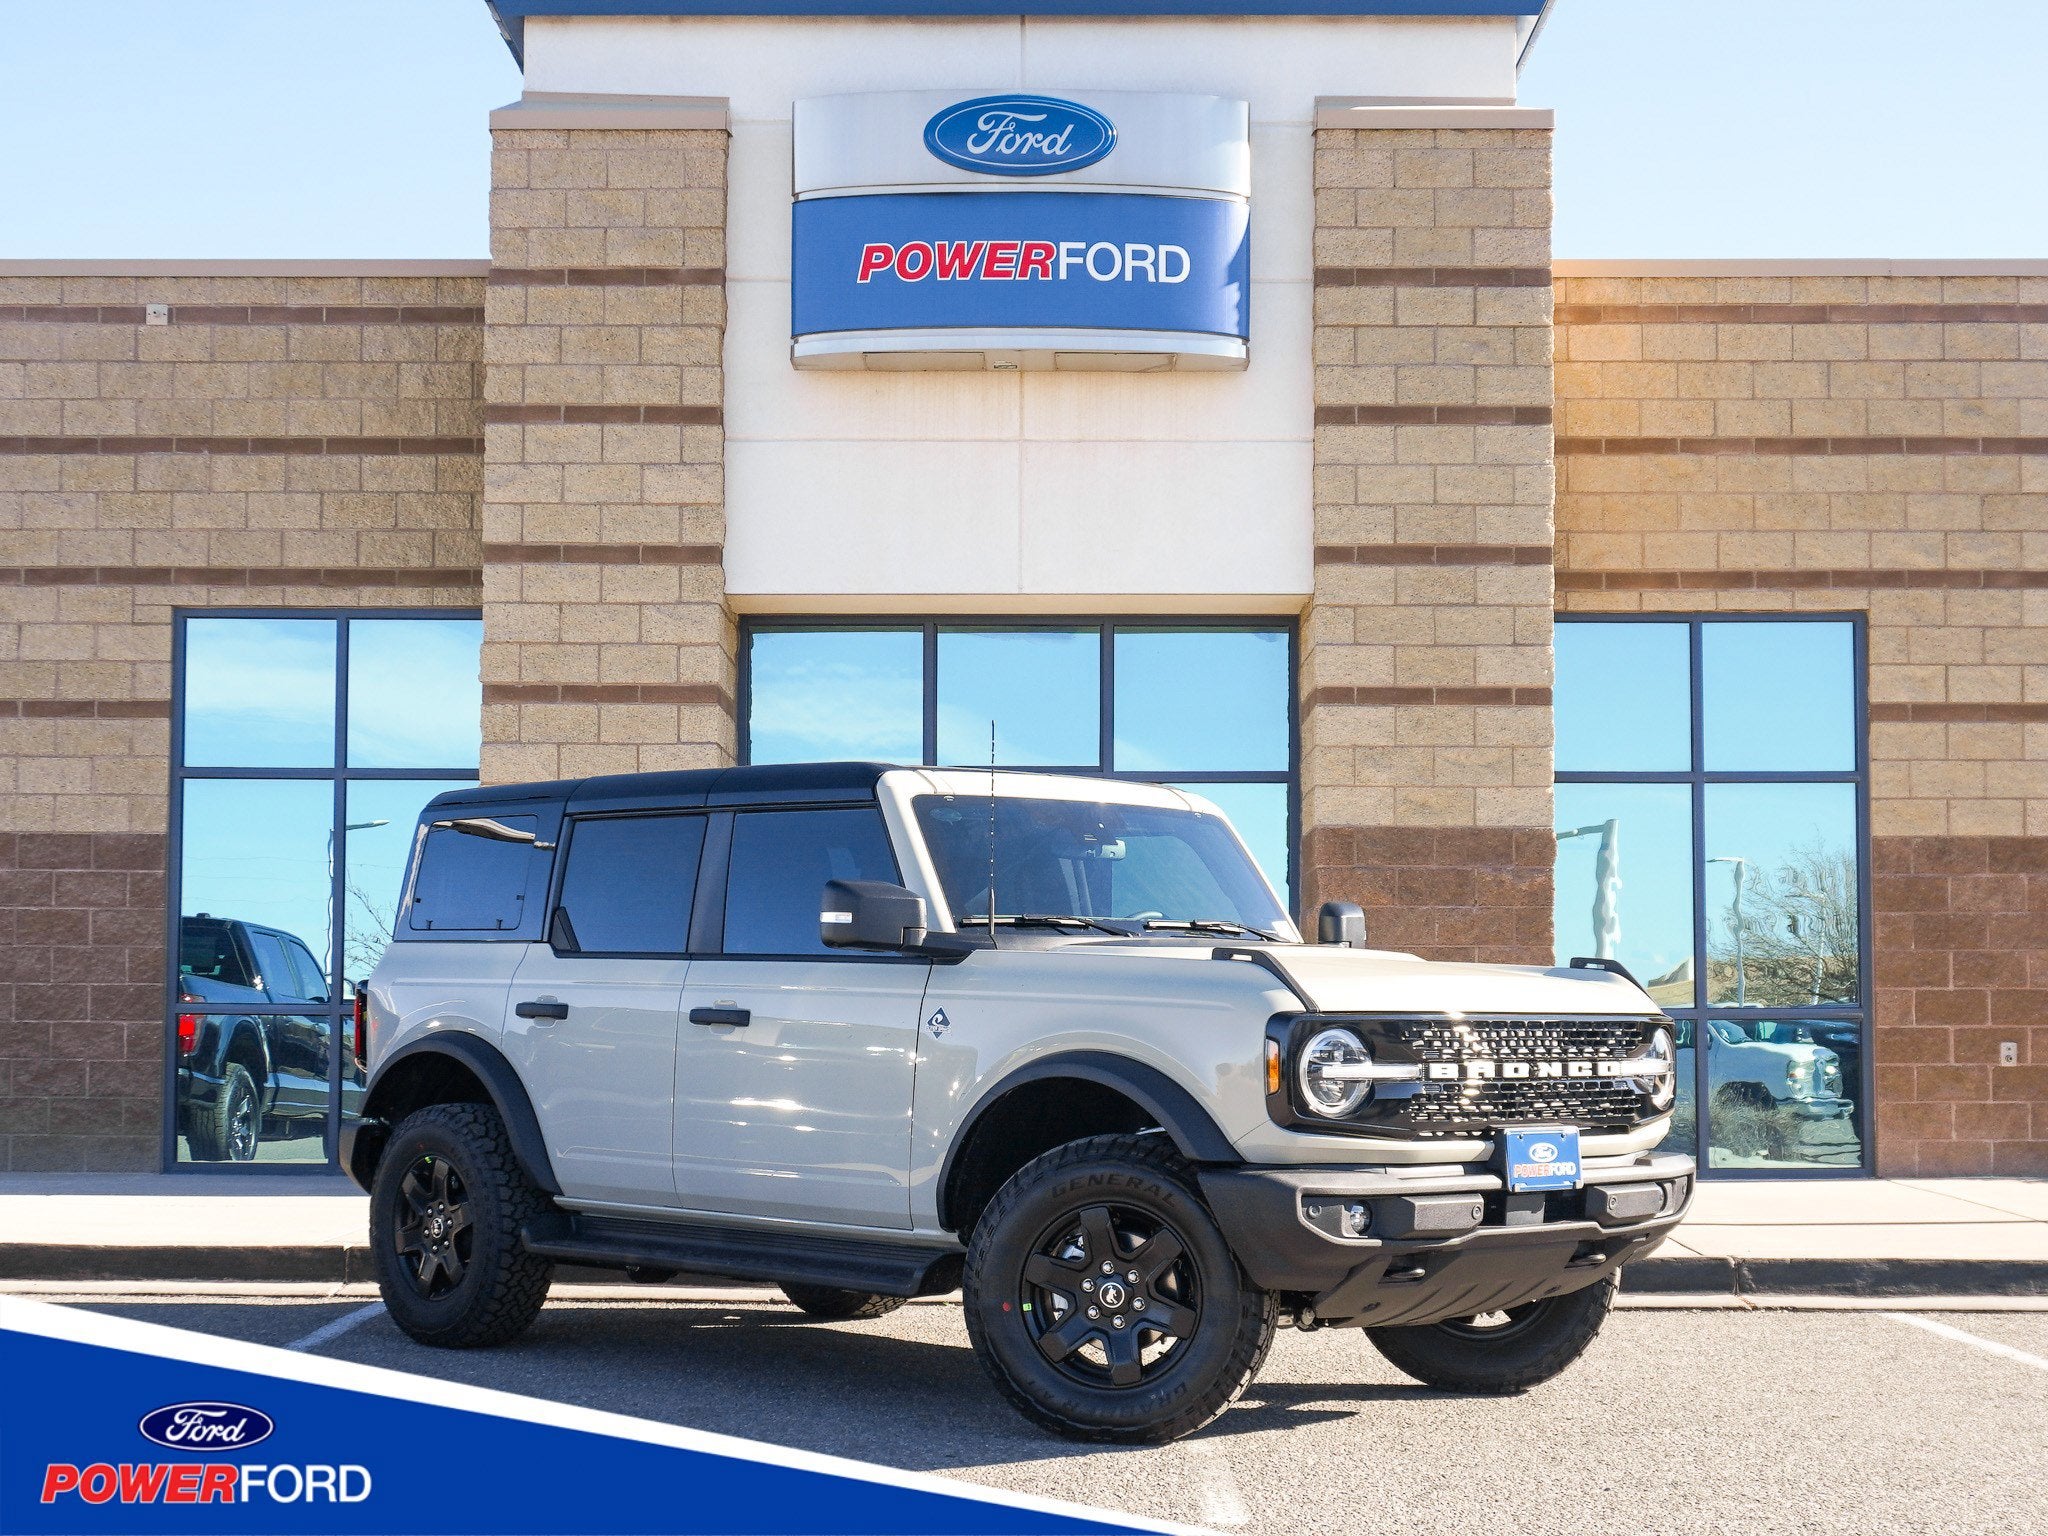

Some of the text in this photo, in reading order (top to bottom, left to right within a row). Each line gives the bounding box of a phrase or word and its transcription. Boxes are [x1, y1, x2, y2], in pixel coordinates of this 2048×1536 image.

[966, 111, 1074, 156] Ford
[857, 240, 1191, 284] POWERFORD
[1429, 1060, 1621, 1079] BRONCO
[1051, 1173, 1176, 1208] GENERAL
